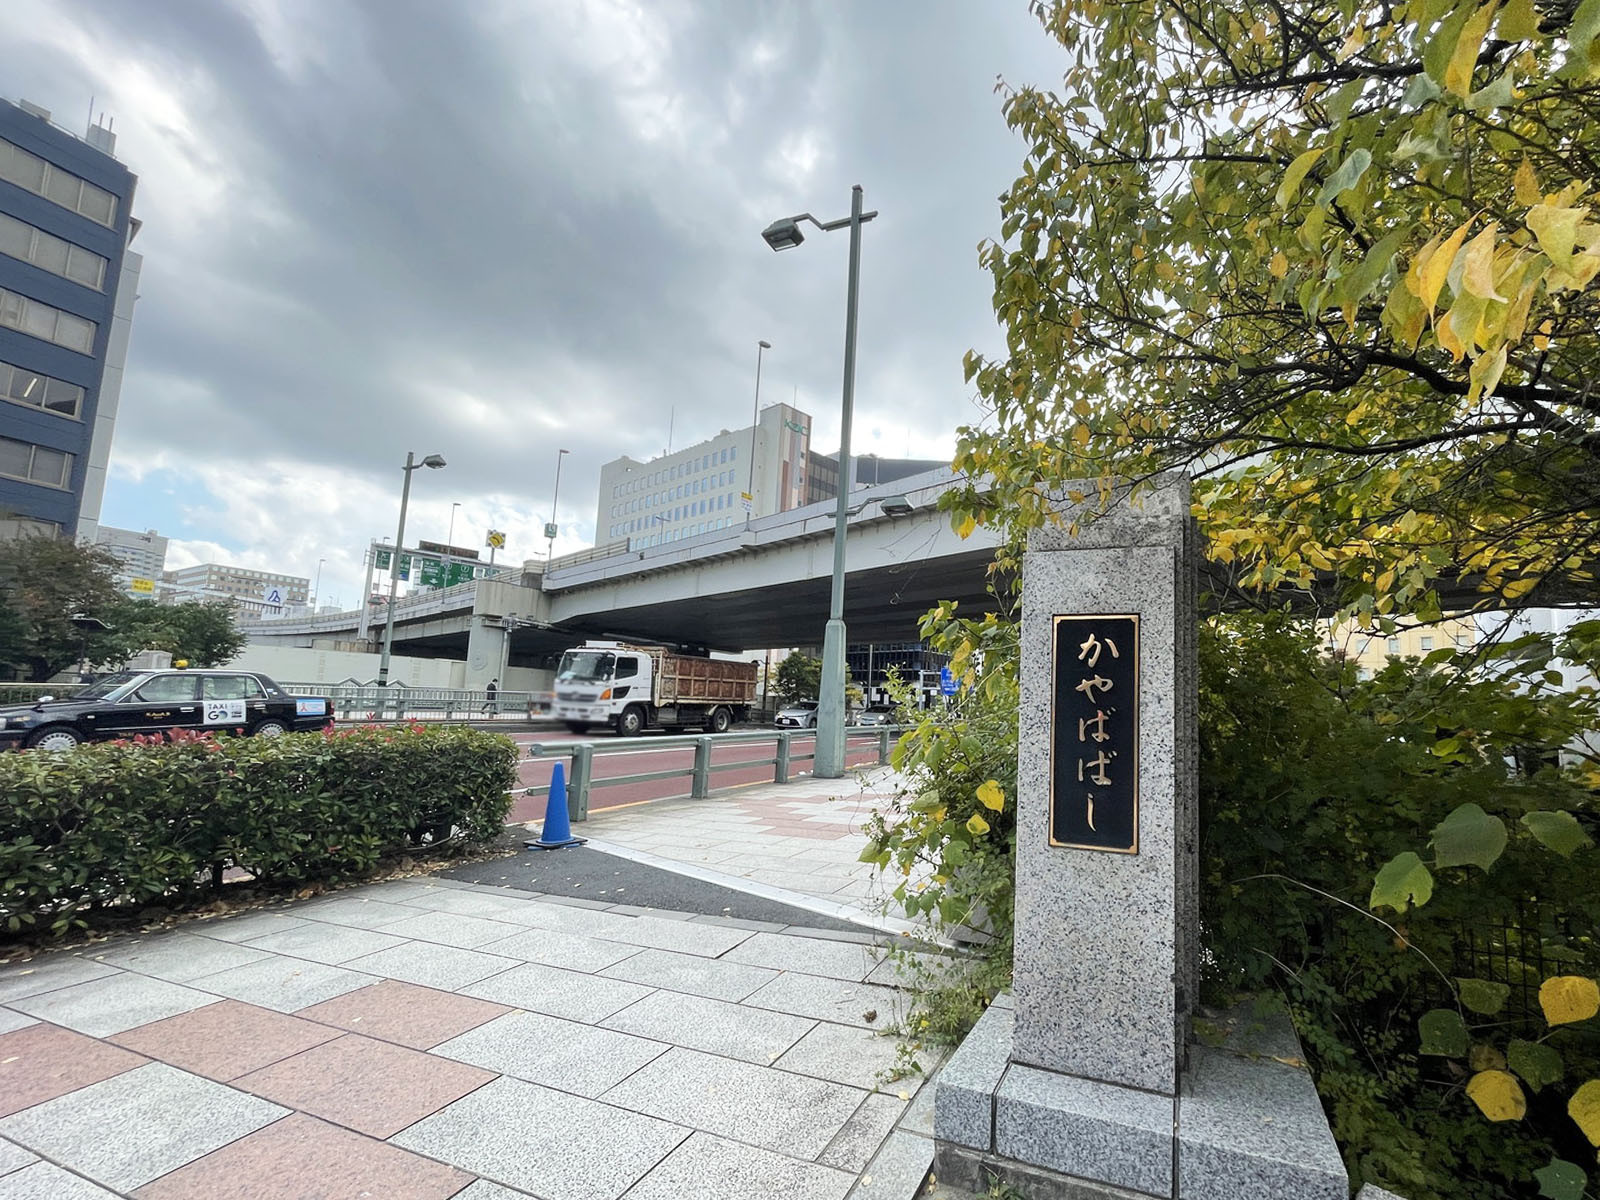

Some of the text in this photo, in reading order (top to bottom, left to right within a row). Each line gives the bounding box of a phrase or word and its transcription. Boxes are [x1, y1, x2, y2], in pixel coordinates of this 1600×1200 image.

[208, 710, 228, 720] GO
[1075, 633, 1120, 832] かやばばし
